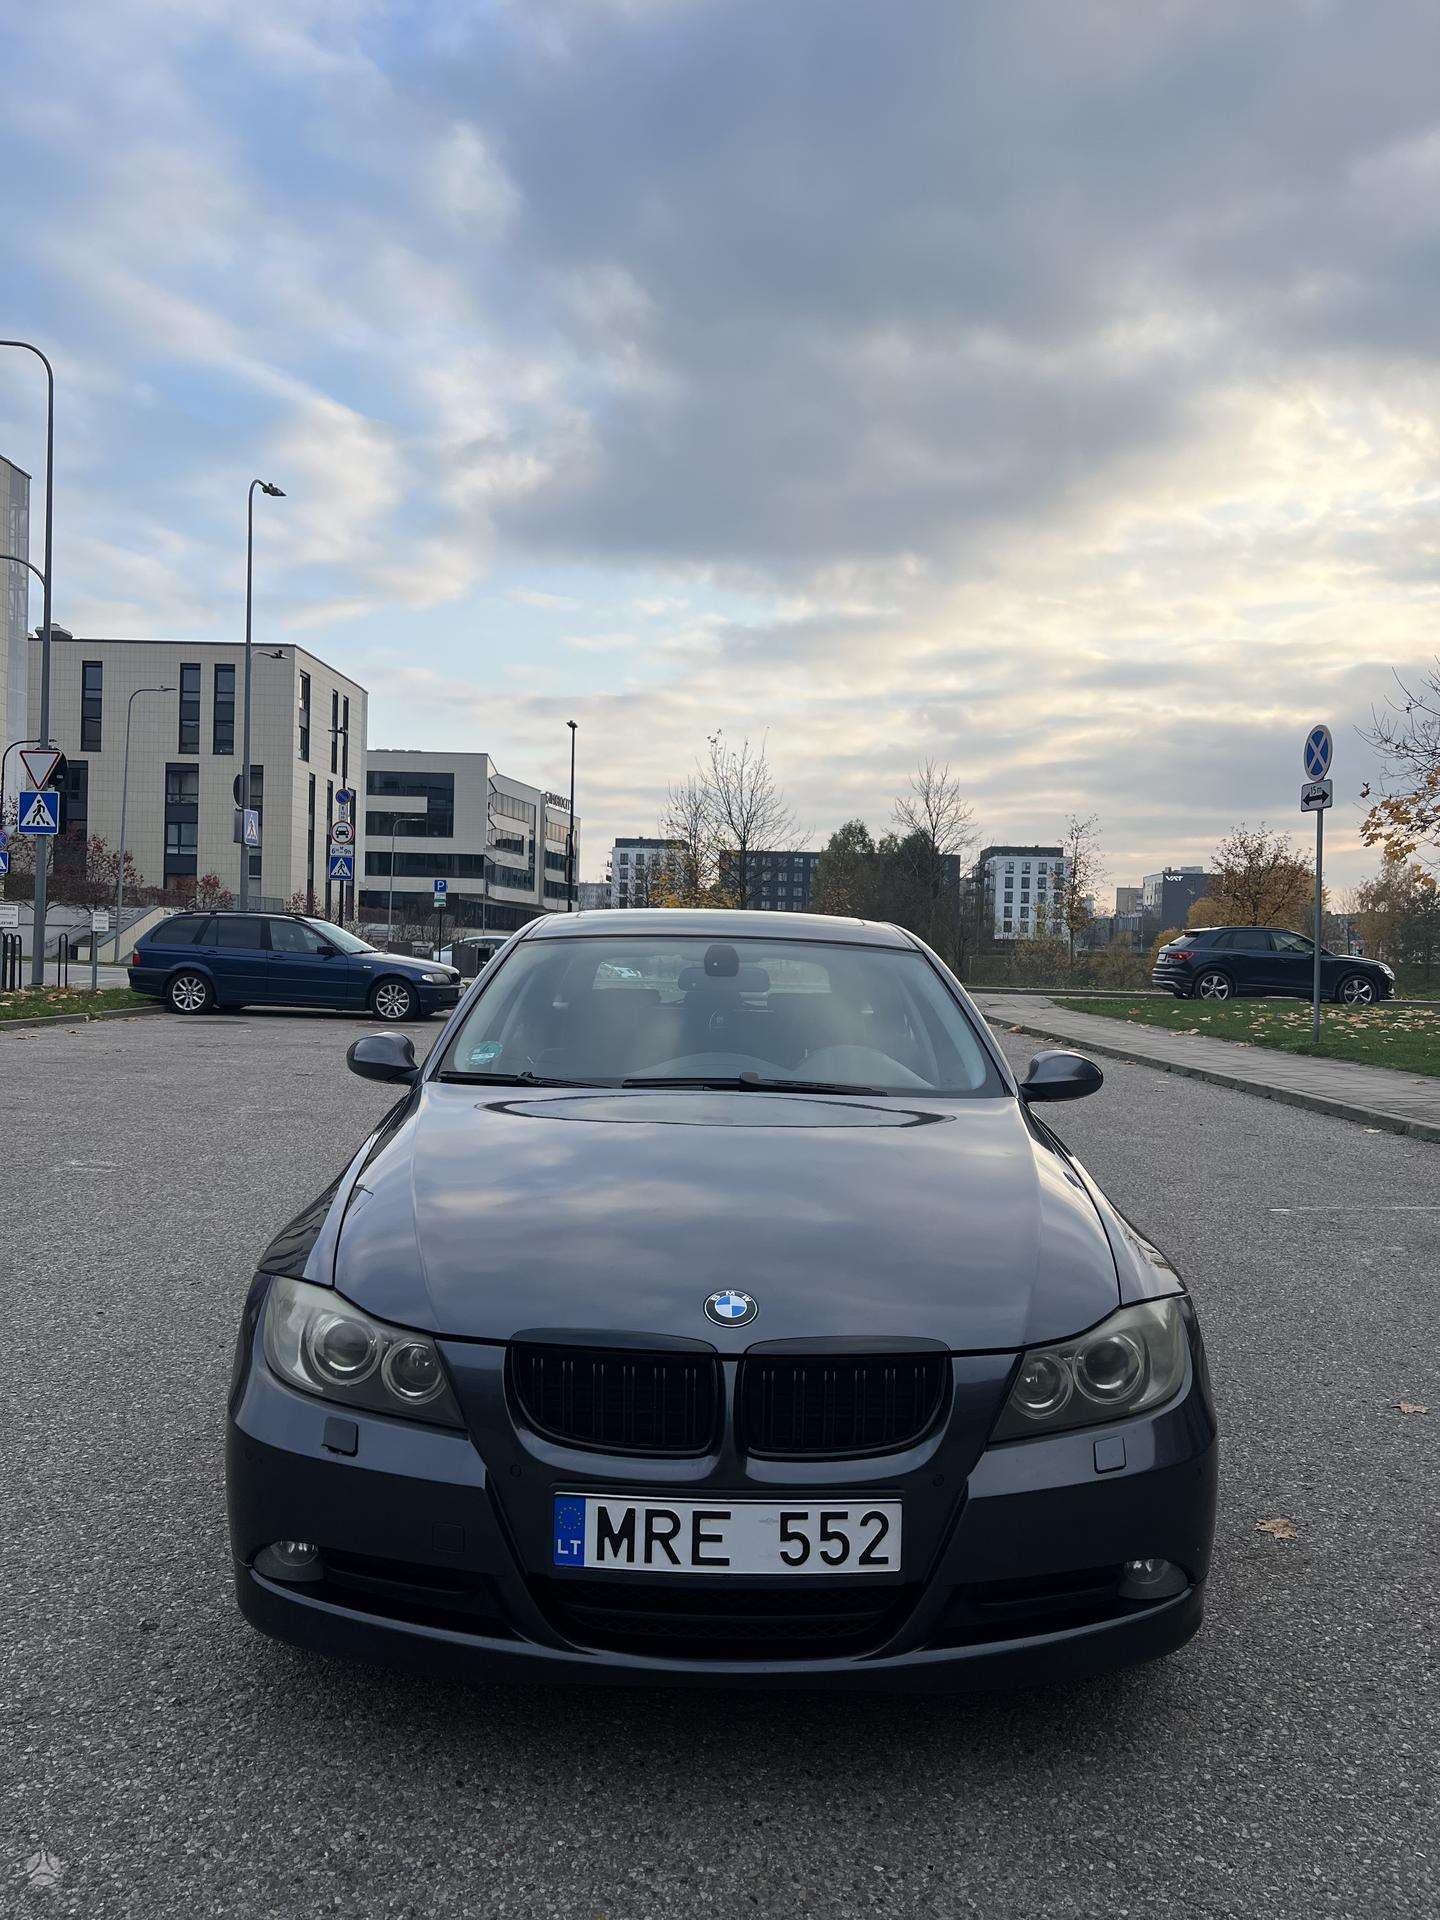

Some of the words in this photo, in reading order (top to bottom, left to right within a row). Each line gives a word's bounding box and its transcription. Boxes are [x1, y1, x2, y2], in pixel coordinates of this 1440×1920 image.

[437, 880, 445, 891] P
[710, 1290, 752, 1302] BMW
[596, 1505, 732, 1566] MRE
[779, 1510, 891, 1567] 552
[557, 1538, 581, 1556] LT
